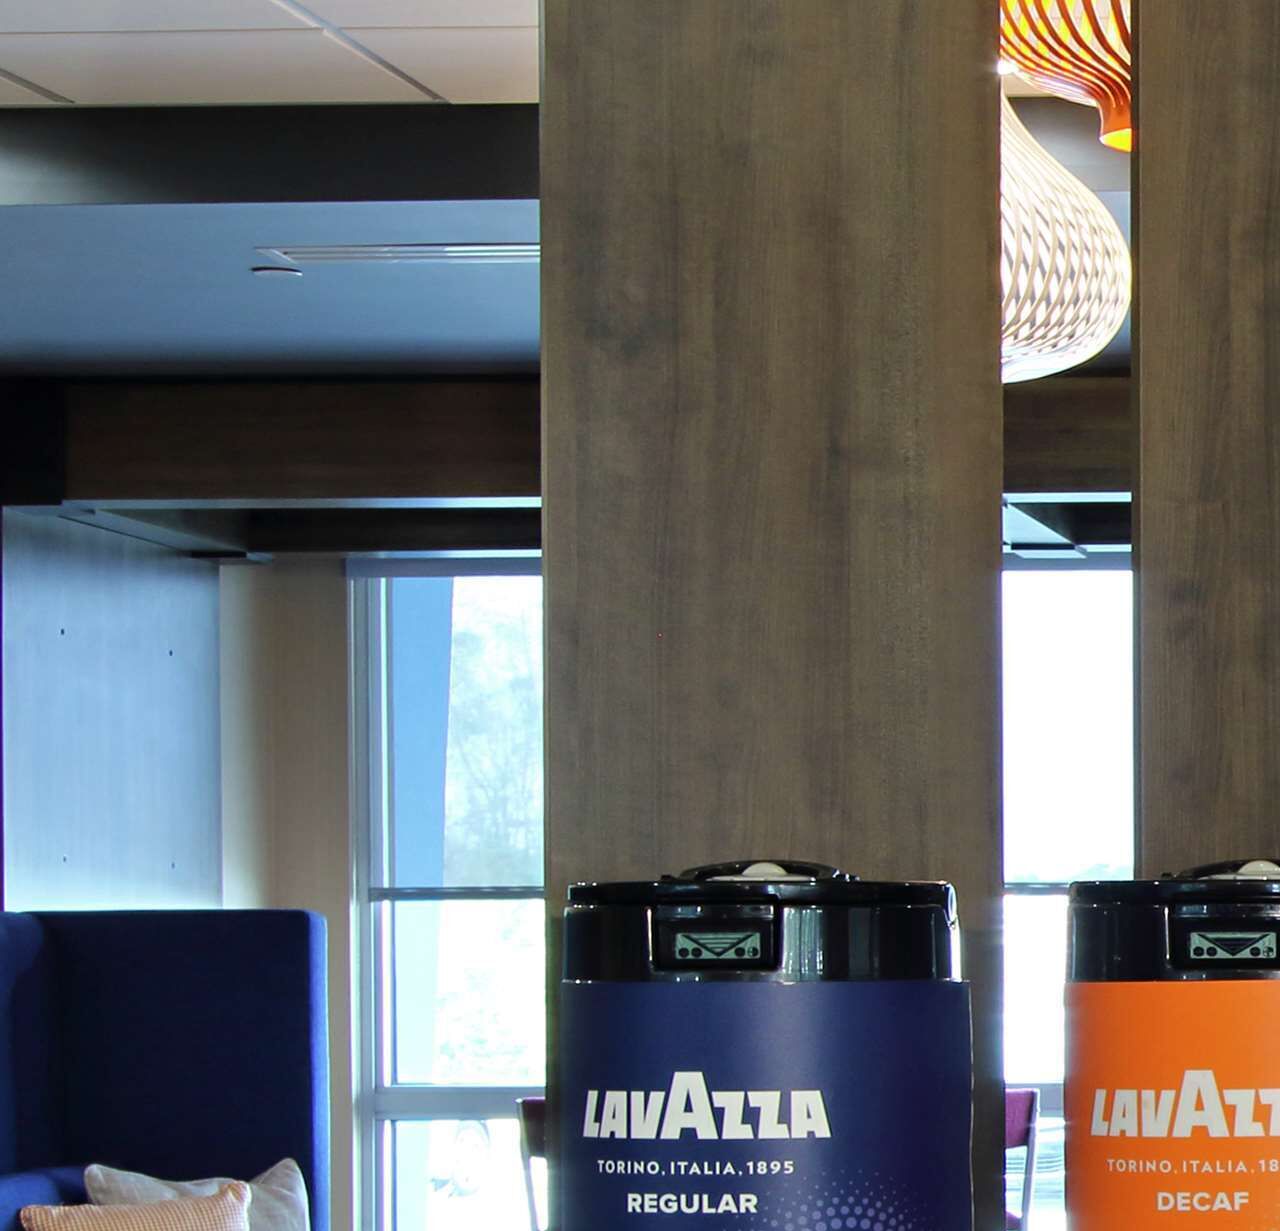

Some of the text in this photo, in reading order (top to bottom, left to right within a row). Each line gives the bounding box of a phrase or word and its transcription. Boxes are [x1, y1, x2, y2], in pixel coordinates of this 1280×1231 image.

[583, 1071, 832, 1140] LAVAZZA
[746, 1160, 795, 1175] 1895
[627, 1193, 758, 1214] REGULAR
[1157, 1191, 1249, 1212] DECAF
